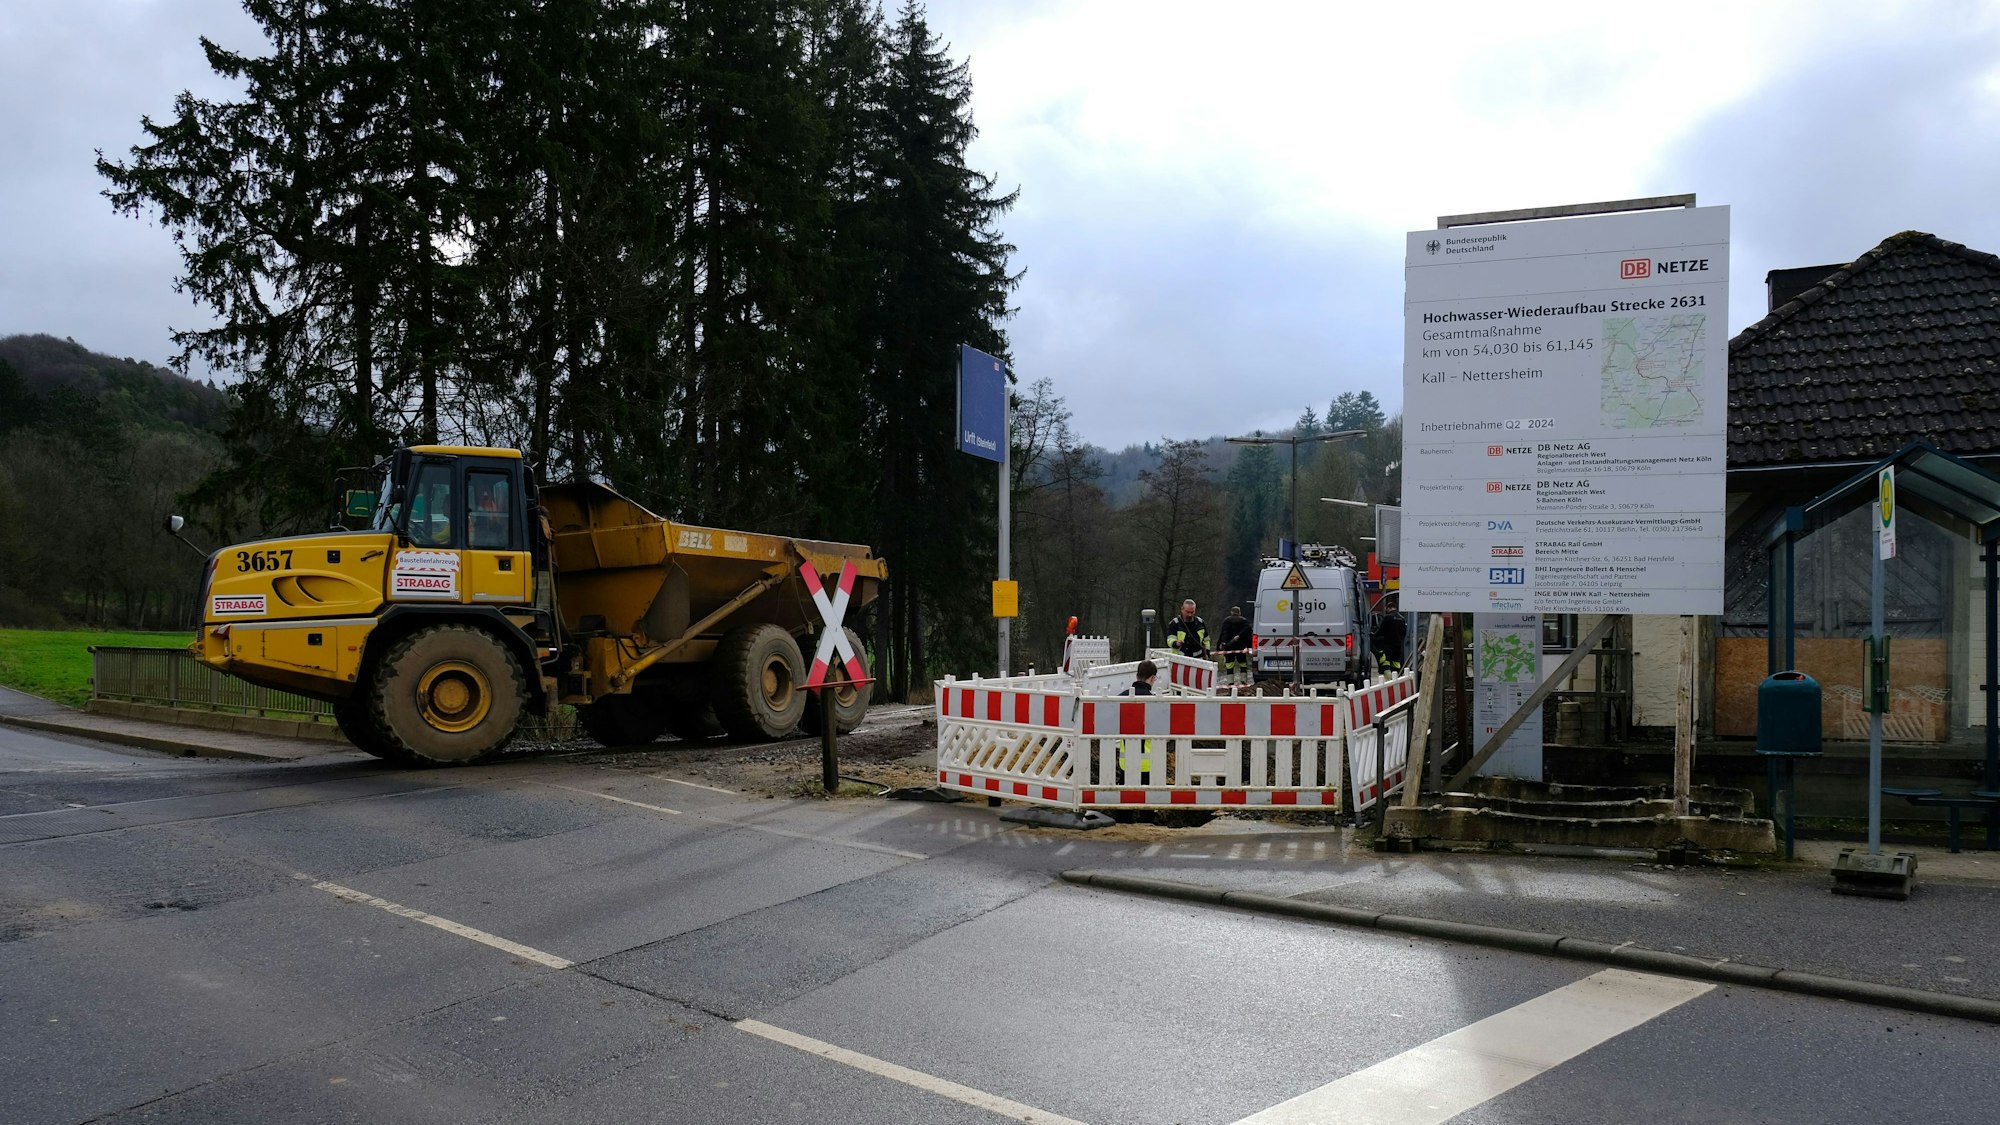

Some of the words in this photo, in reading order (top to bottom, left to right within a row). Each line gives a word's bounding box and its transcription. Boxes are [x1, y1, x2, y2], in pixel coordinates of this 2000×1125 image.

[1446, 234, 1507, 245] Bundesrepublik
[1446, 244, 1494, 254] Deutschland
[1623, 260, 1648, 278] DB
[1657, 259, 1709, 274] NETZE
[1423, 302, 1606, 324] Hochwasser-Wiederaufbau
[1610, 298, 1665, 312] Strecke
[1670, 295, 1706, 308] 2631
[1422, 325, 1542, 341] Gesamtmaßnahme
[1422, 347, 1441, 359] km
[1446, 348, 1468, 358] von
[1473, 342, 1519, 357] 54,030
[1523, 341, 1542, 353] bis
[1546, 338, 1593, 352] 61,145
[1422, 372, 1445, 384] Kall
[1462, 368, 1543, 382] Nettersheim
[1420, 421, 1503, 432] Inbetriebnahme
[1505, 420, 1521, 430] Q2
[1528, 419, 1554, 429] 2024
[964, 430, 976, 445] Urft
[976, 435, 997, 452] (Steinfeld)
[1488, 446, 1502, 456] DB
[1487, 483, 1502, 492] DB
[1576, 480, 1590, 488] AG
[679, 530, 713, 550] BELL
[237, 550, 293, 572] 3657
[400, 557, 456, 565] Baustellenfahrzeug
[397, 577, 451, 589] STRABAG
[215, 601, 264, 610] STRABAG
